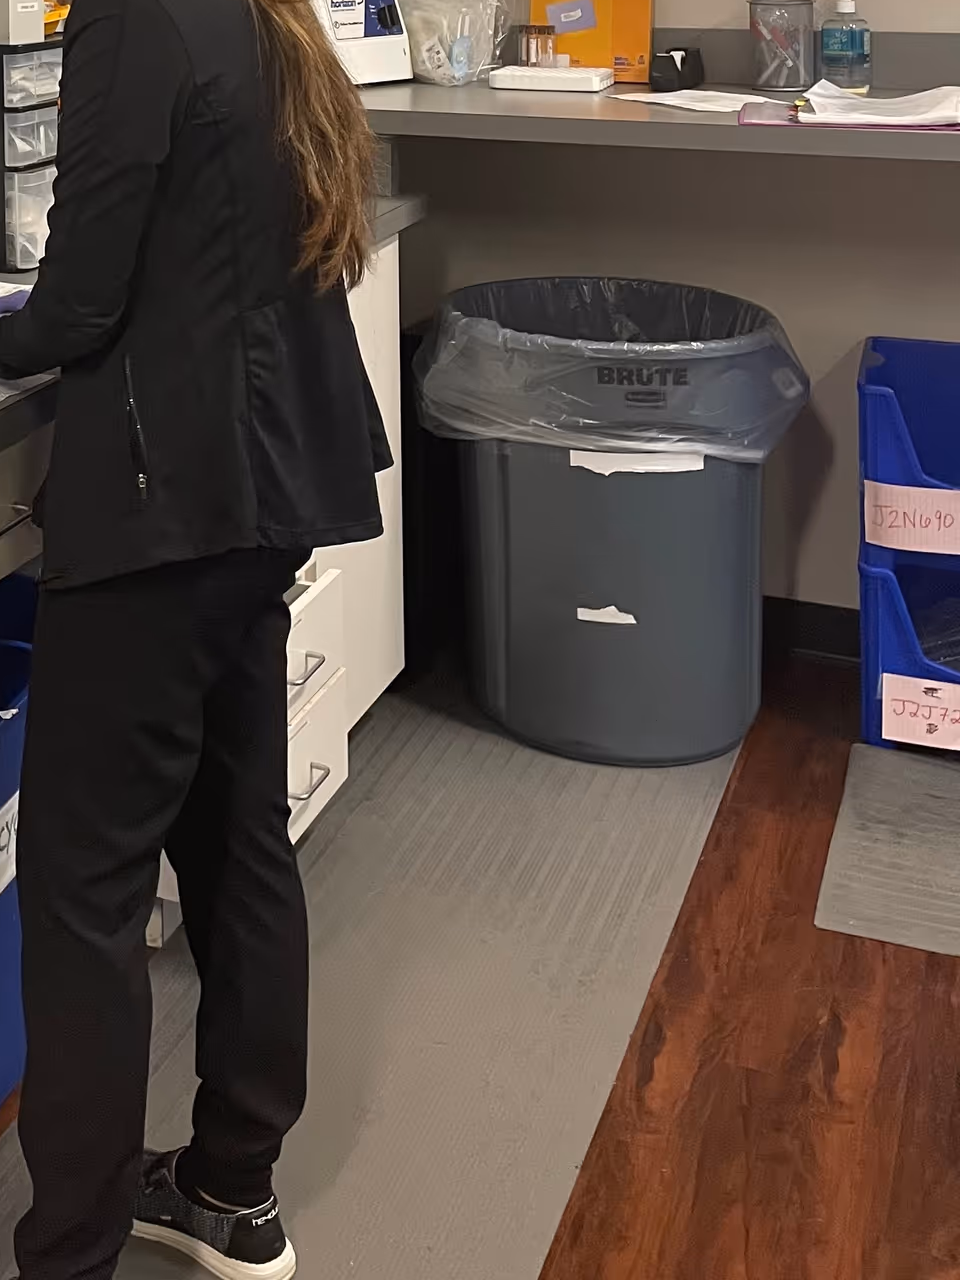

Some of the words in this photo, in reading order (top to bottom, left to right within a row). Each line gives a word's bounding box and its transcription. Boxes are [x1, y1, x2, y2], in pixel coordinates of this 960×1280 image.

[330, 0, 357, 9] horizon
[596, 366, 688, 387] BRUTE
[872, 503, 955, 533] J2N690
